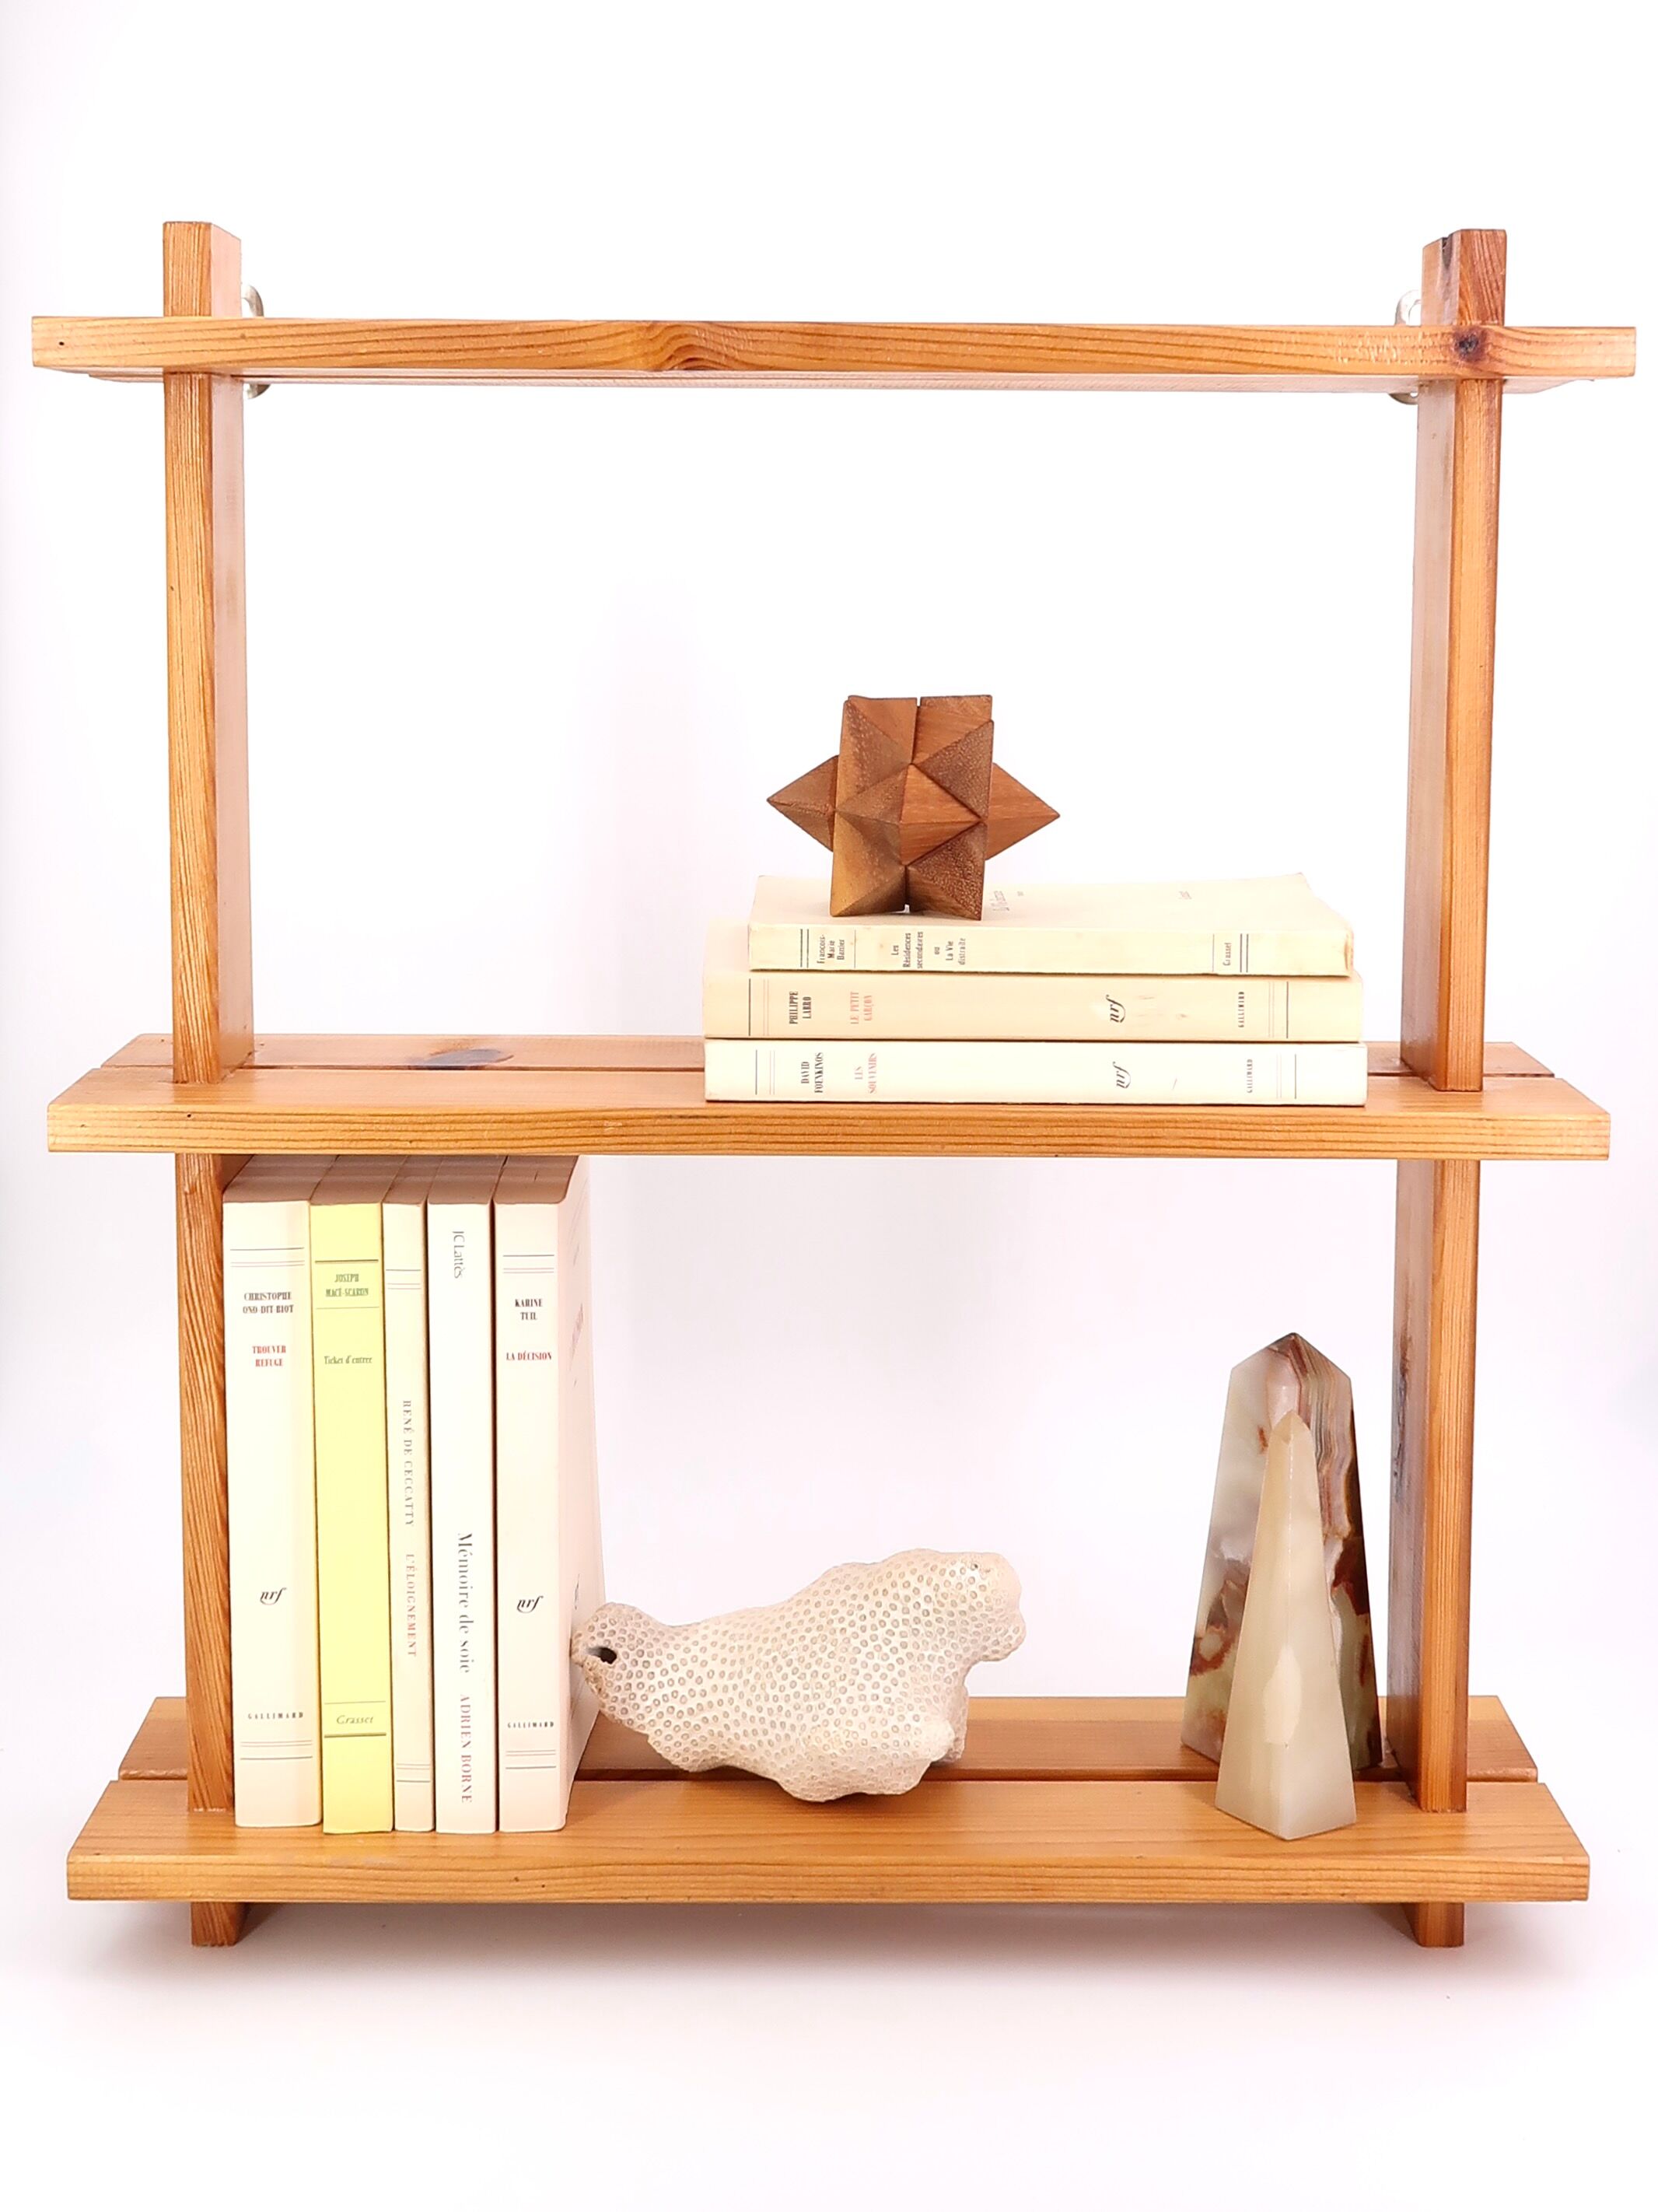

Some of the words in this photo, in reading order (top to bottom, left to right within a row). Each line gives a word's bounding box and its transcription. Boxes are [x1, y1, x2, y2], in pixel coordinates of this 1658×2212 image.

[890, 944, 900, 956] Les
[902, 933, 911, 968] Résidences
[915, 931, 924, 969] secondaires
[945, 940, 954, 951] Vie
[945, 953, 954, 961] La
[789, 991, 799, 1025] PHILIPPE
[849, 991, 859, 1012] PETIT
[849, 1016, 859, 1025] LE
[800, 1061, 810, 1084] DAVID
[813, 1052, 824, 1094] FOENKINOS
[854, 1066, 863, 1080] LES
[867, 1052, 877, 1094] SOUVENIRS
[334, 1273, 359, 1283] JOSEPH
[243, 1291, 292, 1301] CHRISTOPHE
[515, 1298, 542, 1307] KARINE
[519, 1311, 537, 1321] TUIL
[252, 1345, 287, 1354] TROUVER
[505, 1352, 516, 1361] LA
[517, 1350, 552, 1361] DÉCISION
[255, 1358, 283, 1367] REFUGE
[324, 1355, 344, 1365] Ticket
[403, 1400, 414, 1433] RENÉ
[404, 1439, 413, 1455] DE
[404, 1461, 414, 1526] CECCATTY
[457, 1533, 474, 1608] Mémoire
[260, 1587, 287, 1605] nrf
[516, 1595, 544, 1613] nrf
[459, 1614, 474, 1634] de
[460, 1640, 474, 1673] soie
[247, 1711, 304, 1720] GALLIMARD
[336, 1714, 374, 1724] Grasset
[460, 1696, 472, 1748] ADRIEN
[507, 1720, 554, 1729] GALLIMARD
[460, 1755, 473, 1803] BORNE
